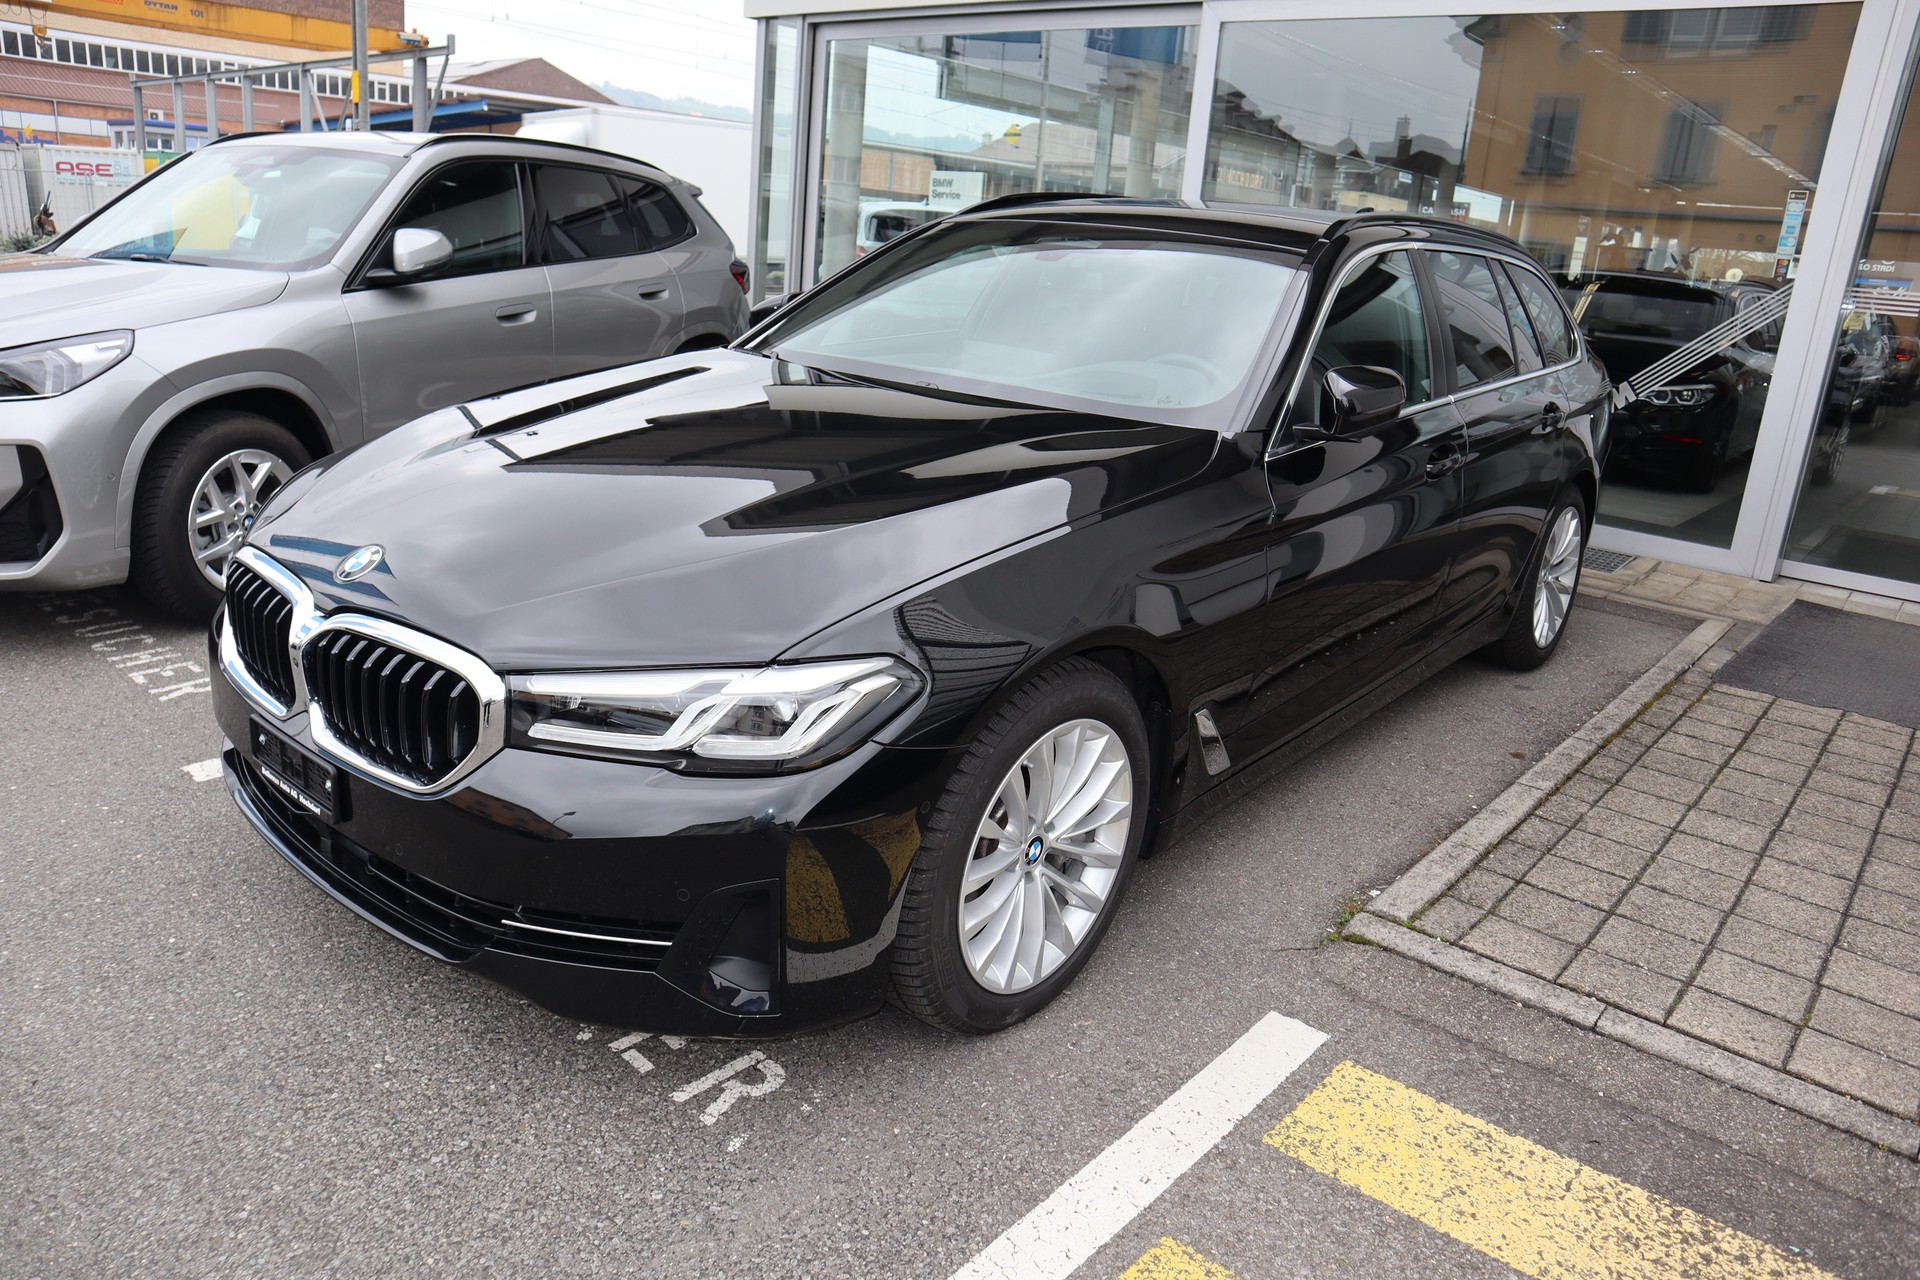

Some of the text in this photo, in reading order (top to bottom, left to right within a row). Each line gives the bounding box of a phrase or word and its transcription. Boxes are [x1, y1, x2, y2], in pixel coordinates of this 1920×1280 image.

[56, 161, 114, 177] ASE
[932, 178, 953, 188] BMW
[931, 189, 961, 200] Service
